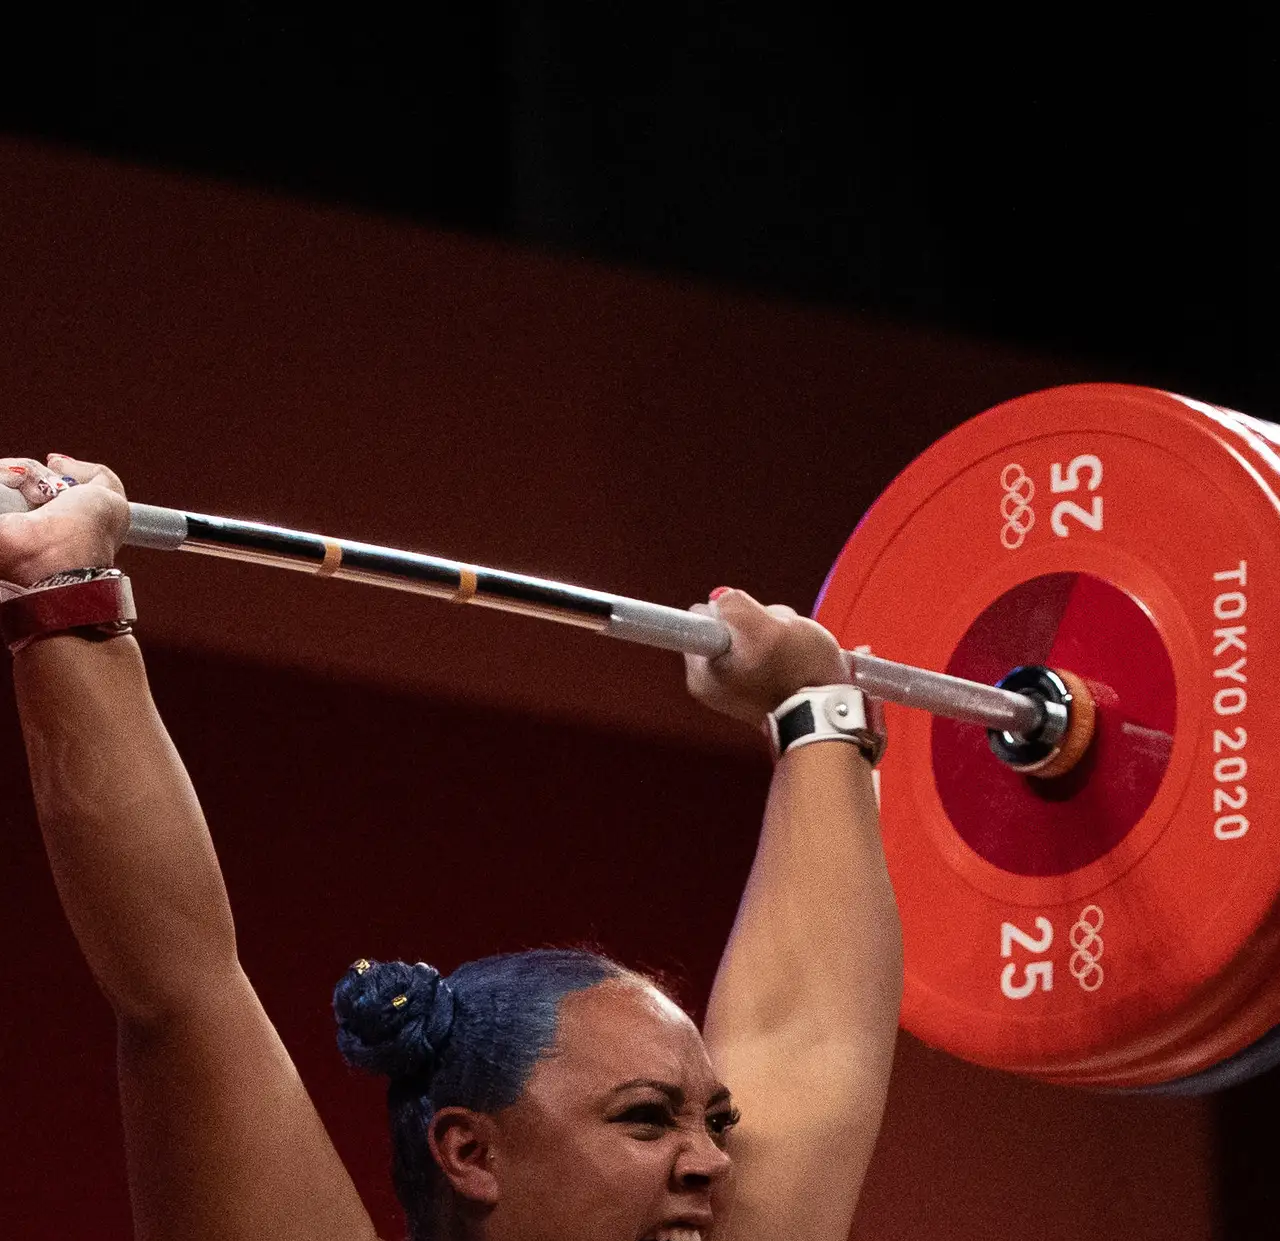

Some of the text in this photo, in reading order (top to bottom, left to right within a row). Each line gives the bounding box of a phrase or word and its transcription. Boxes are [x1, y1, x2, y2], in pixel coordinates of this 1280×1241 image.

[1050, 454, 1103, 537] 25
[1212, 560, 1250, 841] TOKYO 2020
[1000, 917, 1054, 1000] 25
